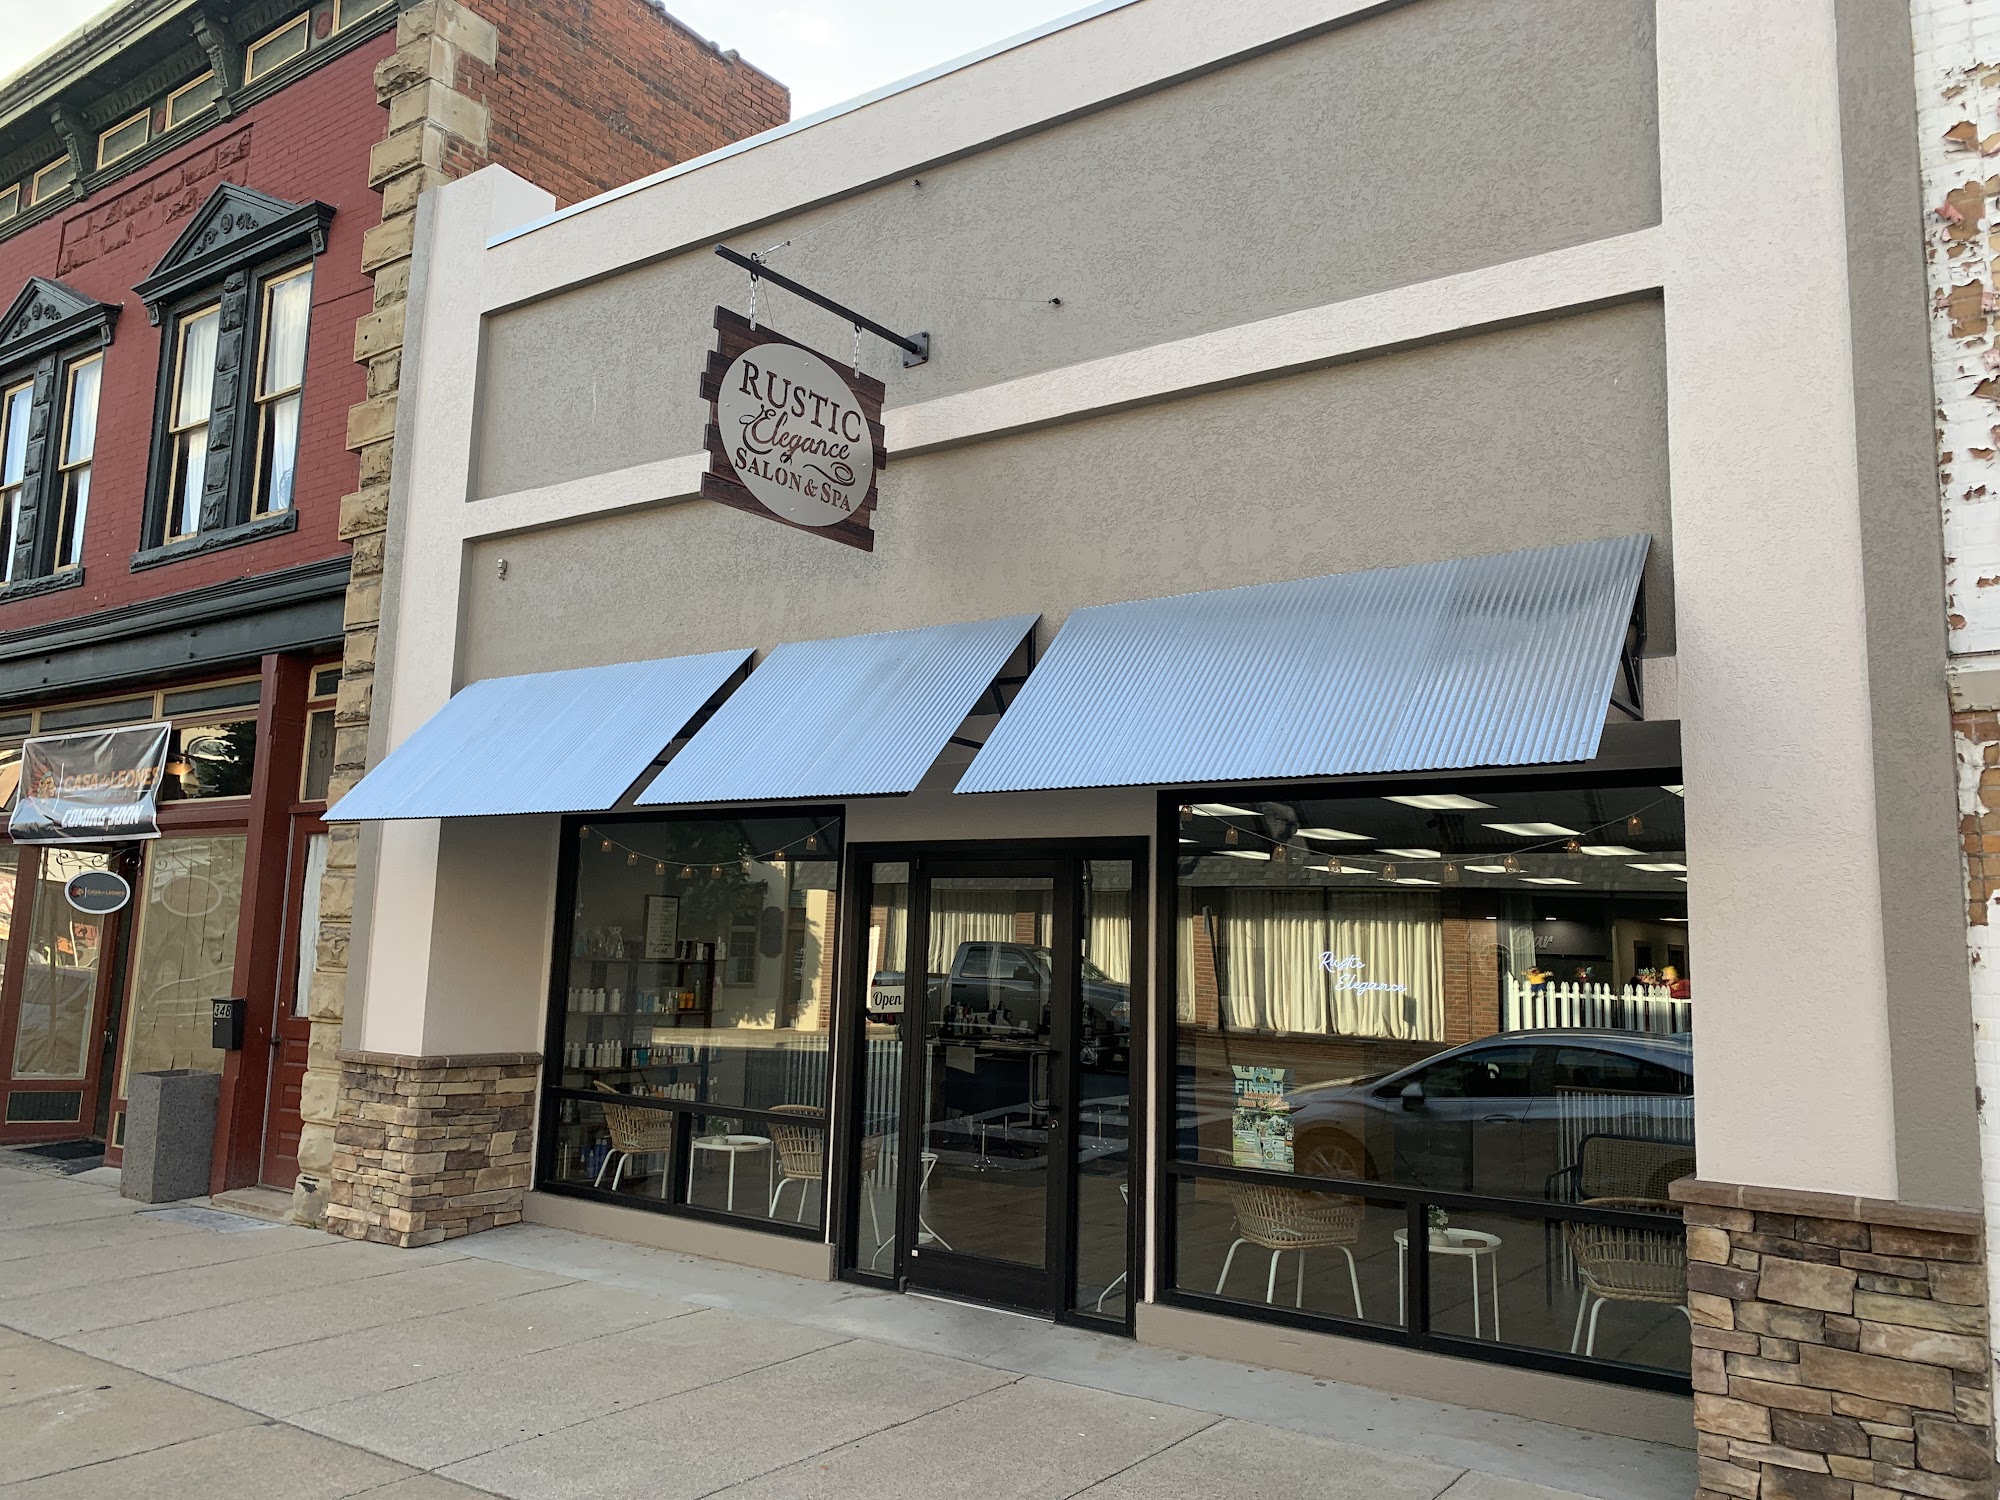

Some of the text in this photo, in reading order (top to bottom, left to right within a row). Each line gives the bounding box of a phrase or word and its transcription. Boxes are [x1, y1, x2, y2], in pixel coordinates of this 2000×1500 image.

[739, 359, 861, 442] RUSTIC
[739, 404, 851, 465] Elegance
[735, 447, 851, 512] SALON & SPA
[64, 773, 98, 791] CASA
[61, 805, 144, 828] COMING SOON
[1335, 974, 1407, 996] Elegance
[214, 1004, 231, 1017] 348
[873, 991, 903, 1010] Open
